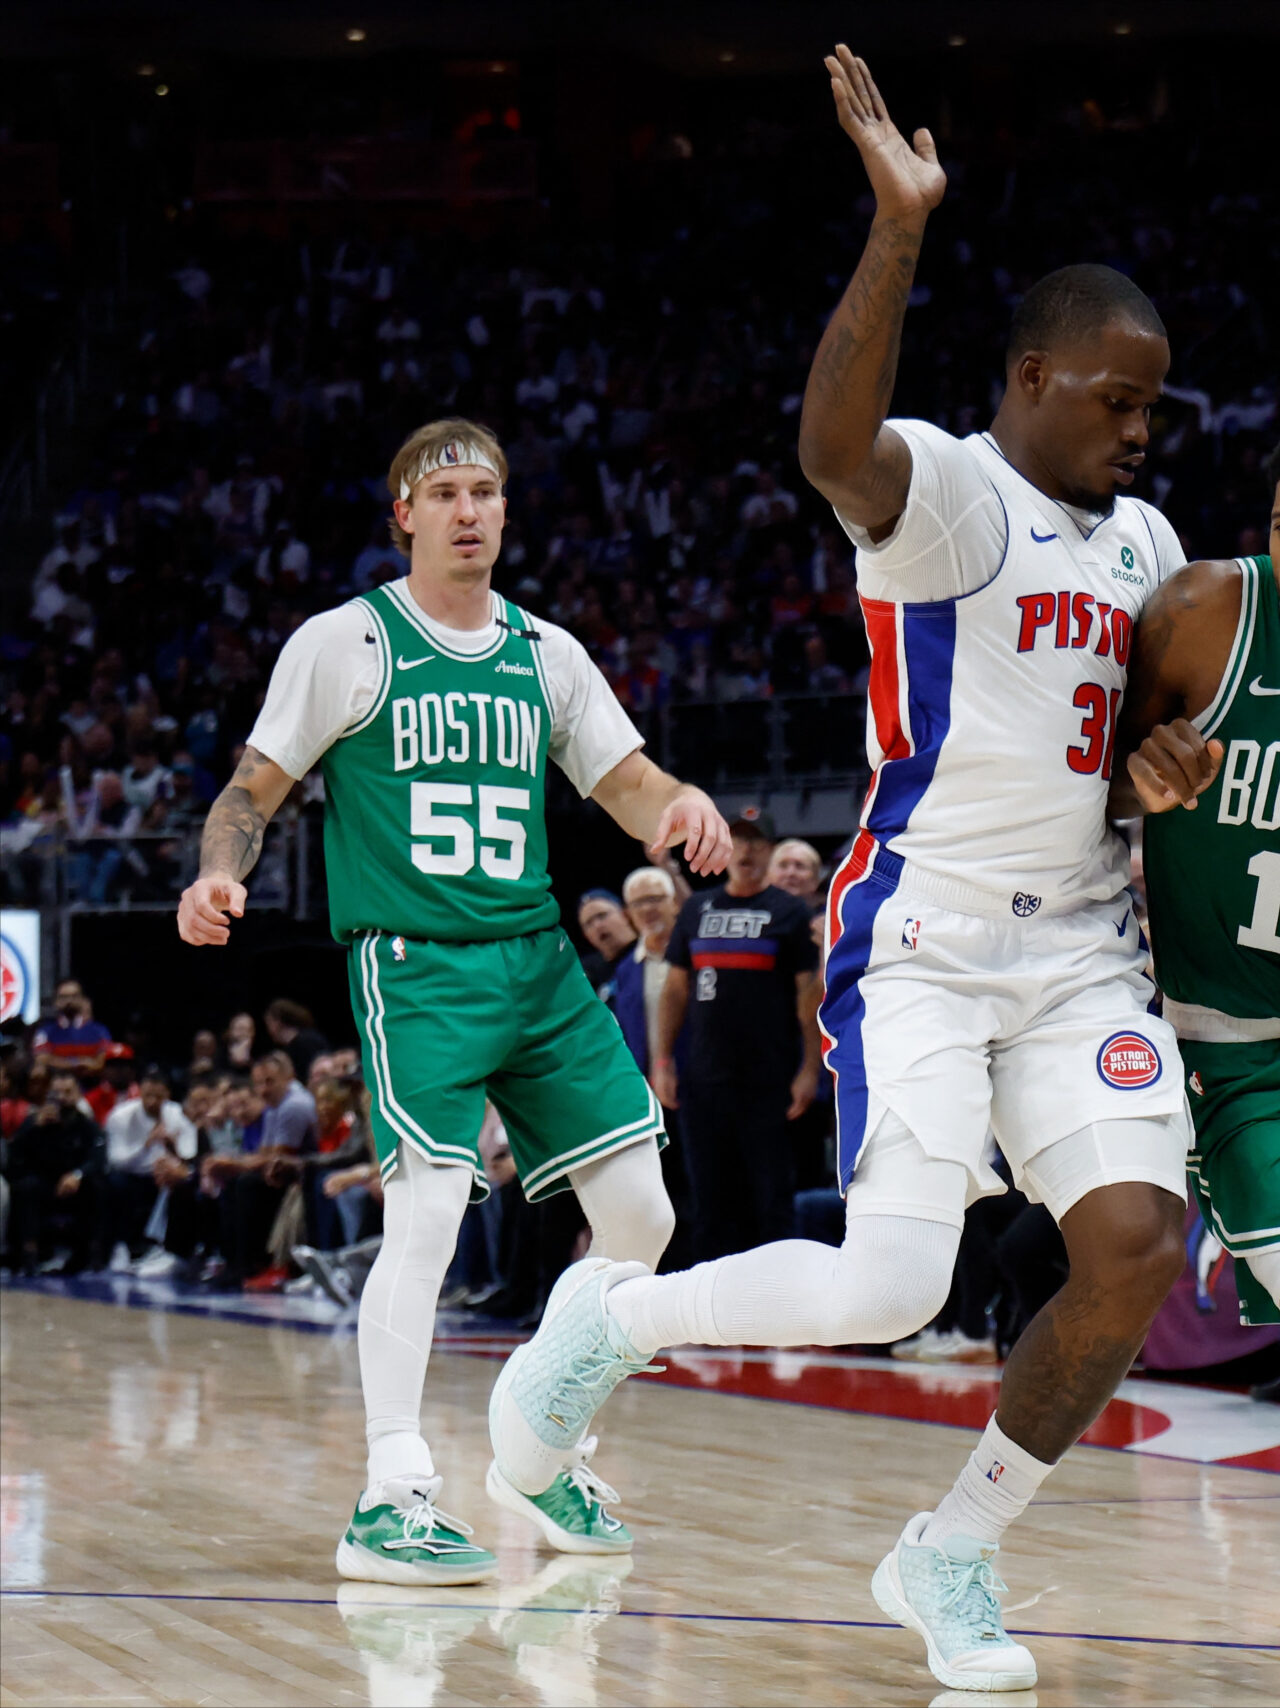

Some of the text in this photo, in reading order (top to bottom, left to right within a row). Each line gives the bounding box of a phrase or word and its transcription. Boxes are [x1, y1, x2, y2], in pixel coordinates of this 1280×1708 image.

[1111, 568, 1145, 586] StockX
[495, 660, 534, 676] Amica
[392, 692, 541, 778] BOSTON
[410, 781, 531, 881] 55
[697, 908, 772, 939] DET
[1109, 1051, 1149, 1062] DETROIT
[1110, 1061, 1151, 1072] PISTONS
